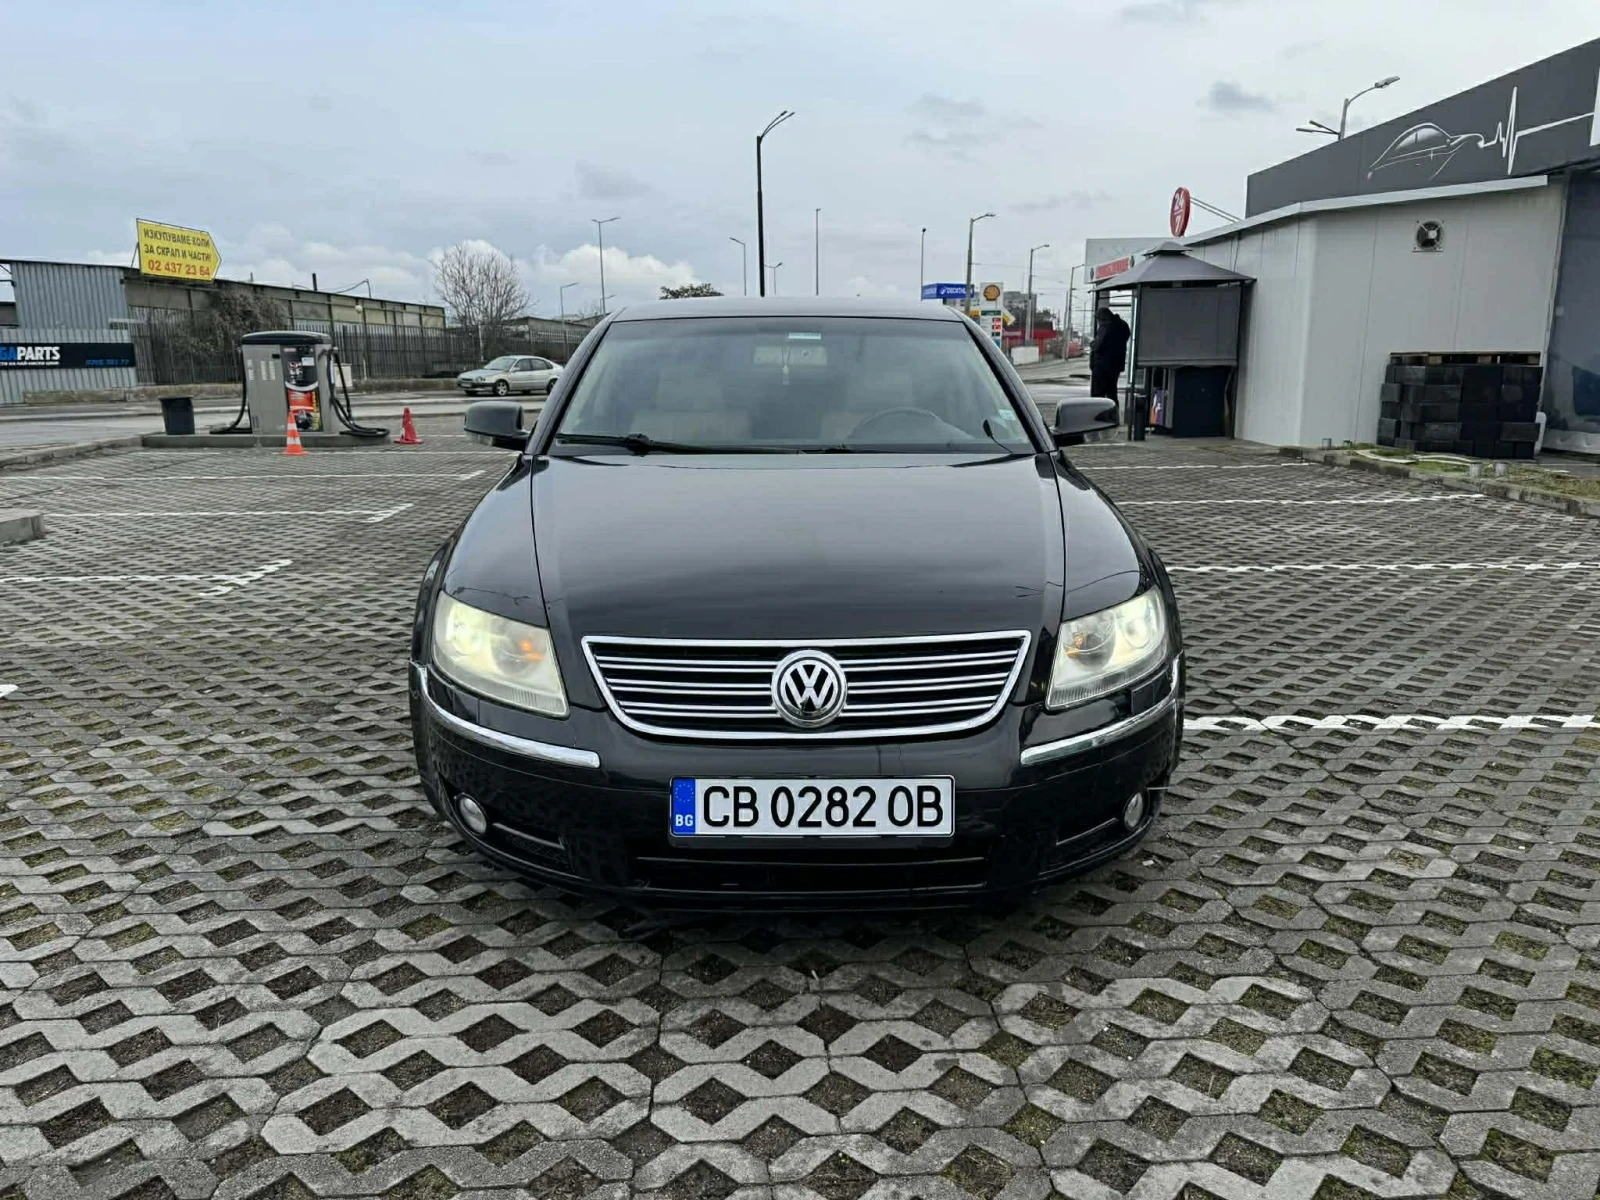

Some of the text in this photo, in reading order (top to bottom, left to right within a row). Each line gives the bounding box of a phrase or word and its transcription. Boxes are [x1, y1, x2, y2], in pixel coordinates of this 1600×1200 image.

[1174, 190, 1184, 210] 24
[1175, 215, 1182, 233] 7
[144, 229, 210, 248] ИЗКУПУВАМЕ КОЛИ
[144, 244, 154, 254] ЗА
[156, 246, 180, 258] СКРАП
[148, 259, 161, 271] 02
[165, 261, 182, 273] 437
[185, 264, 197, 275] 23
[780, 658, 840, 714] VW
[703, 785, 944, 828] CB 0282 OB
[675, 815, 694, 827] BG
